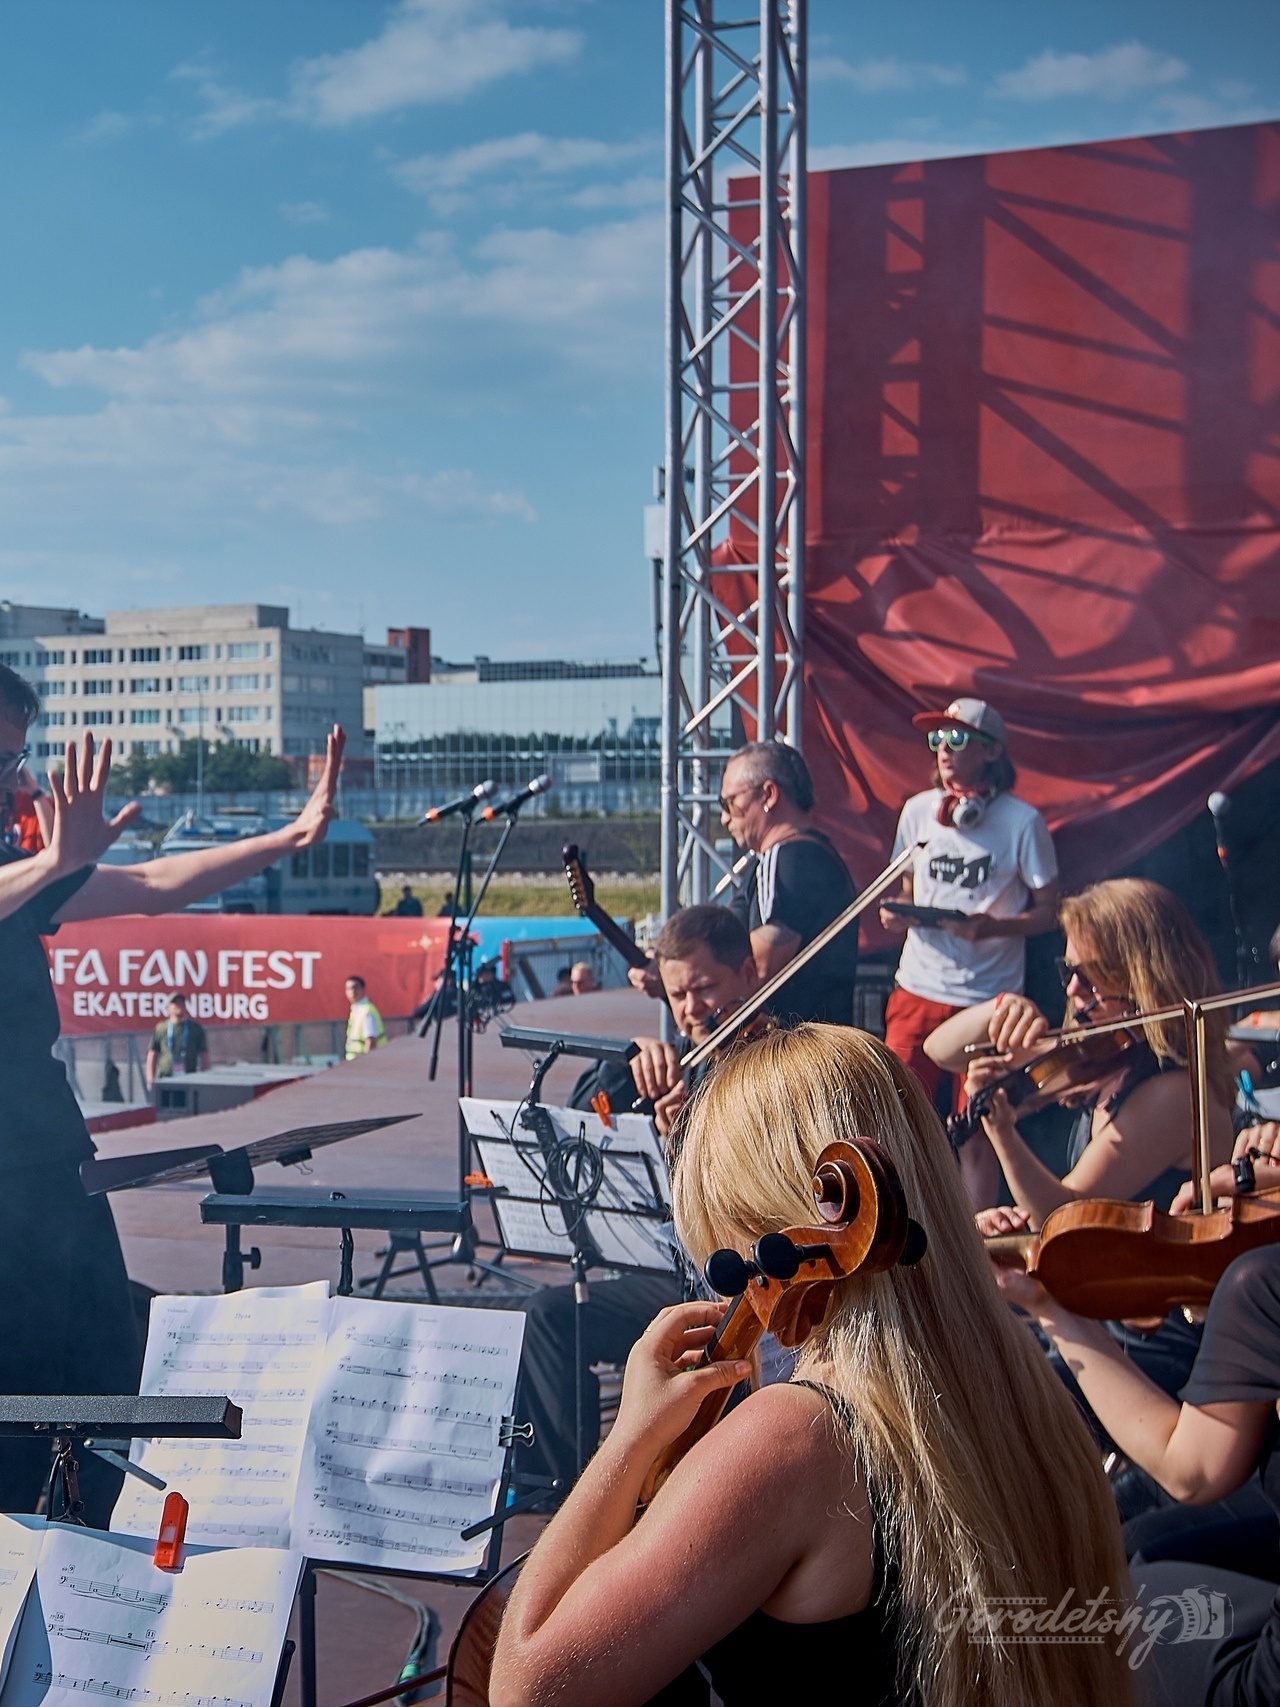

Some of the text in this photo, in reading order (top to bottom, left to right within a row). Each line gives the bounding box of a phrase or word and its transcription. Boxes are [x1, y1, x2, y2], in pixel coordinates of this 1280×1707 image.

[50, 948, 323, 990] FA FAN FEST
[72, 990, 270, 1020] EKATERNBURG
